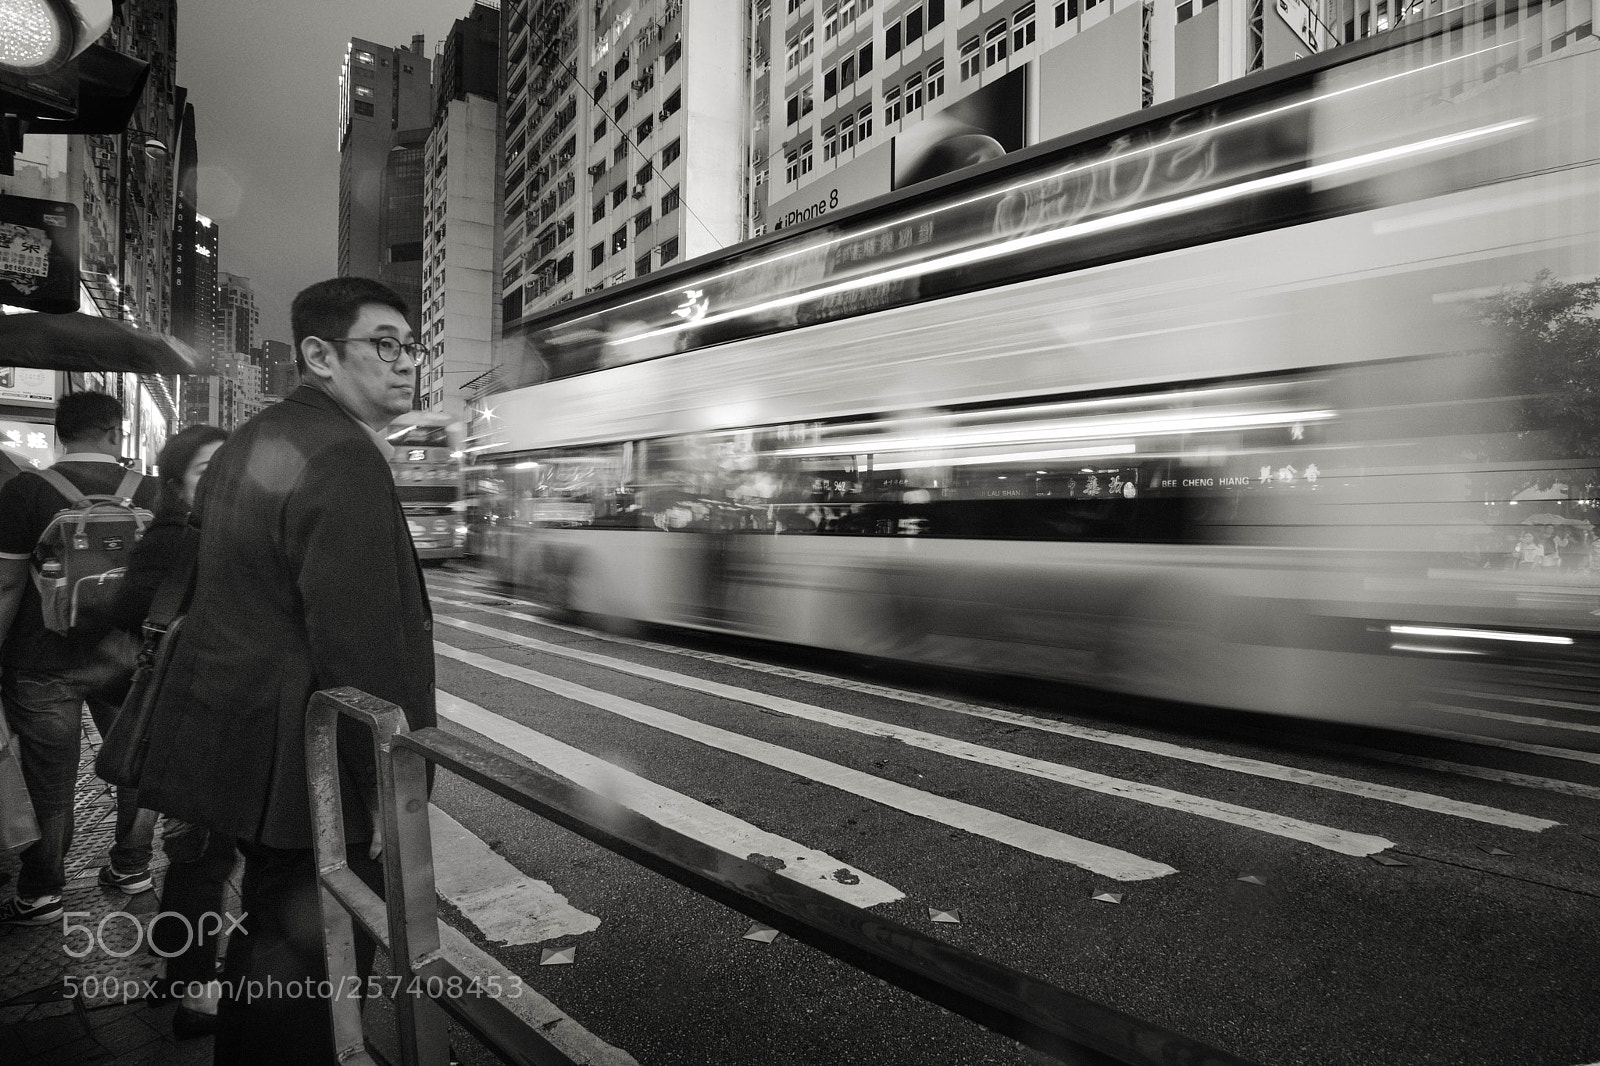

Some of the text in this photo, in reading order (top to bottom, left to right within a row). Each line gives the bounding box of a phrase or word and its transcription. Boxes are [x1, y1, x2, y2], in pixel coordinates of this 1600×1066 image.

[784, 188, 839, 228] iPhone 8
[1161, 476, 1250, 488] BEE CHENG HIANG
[1002, 488, 1021, 496] SHAN
